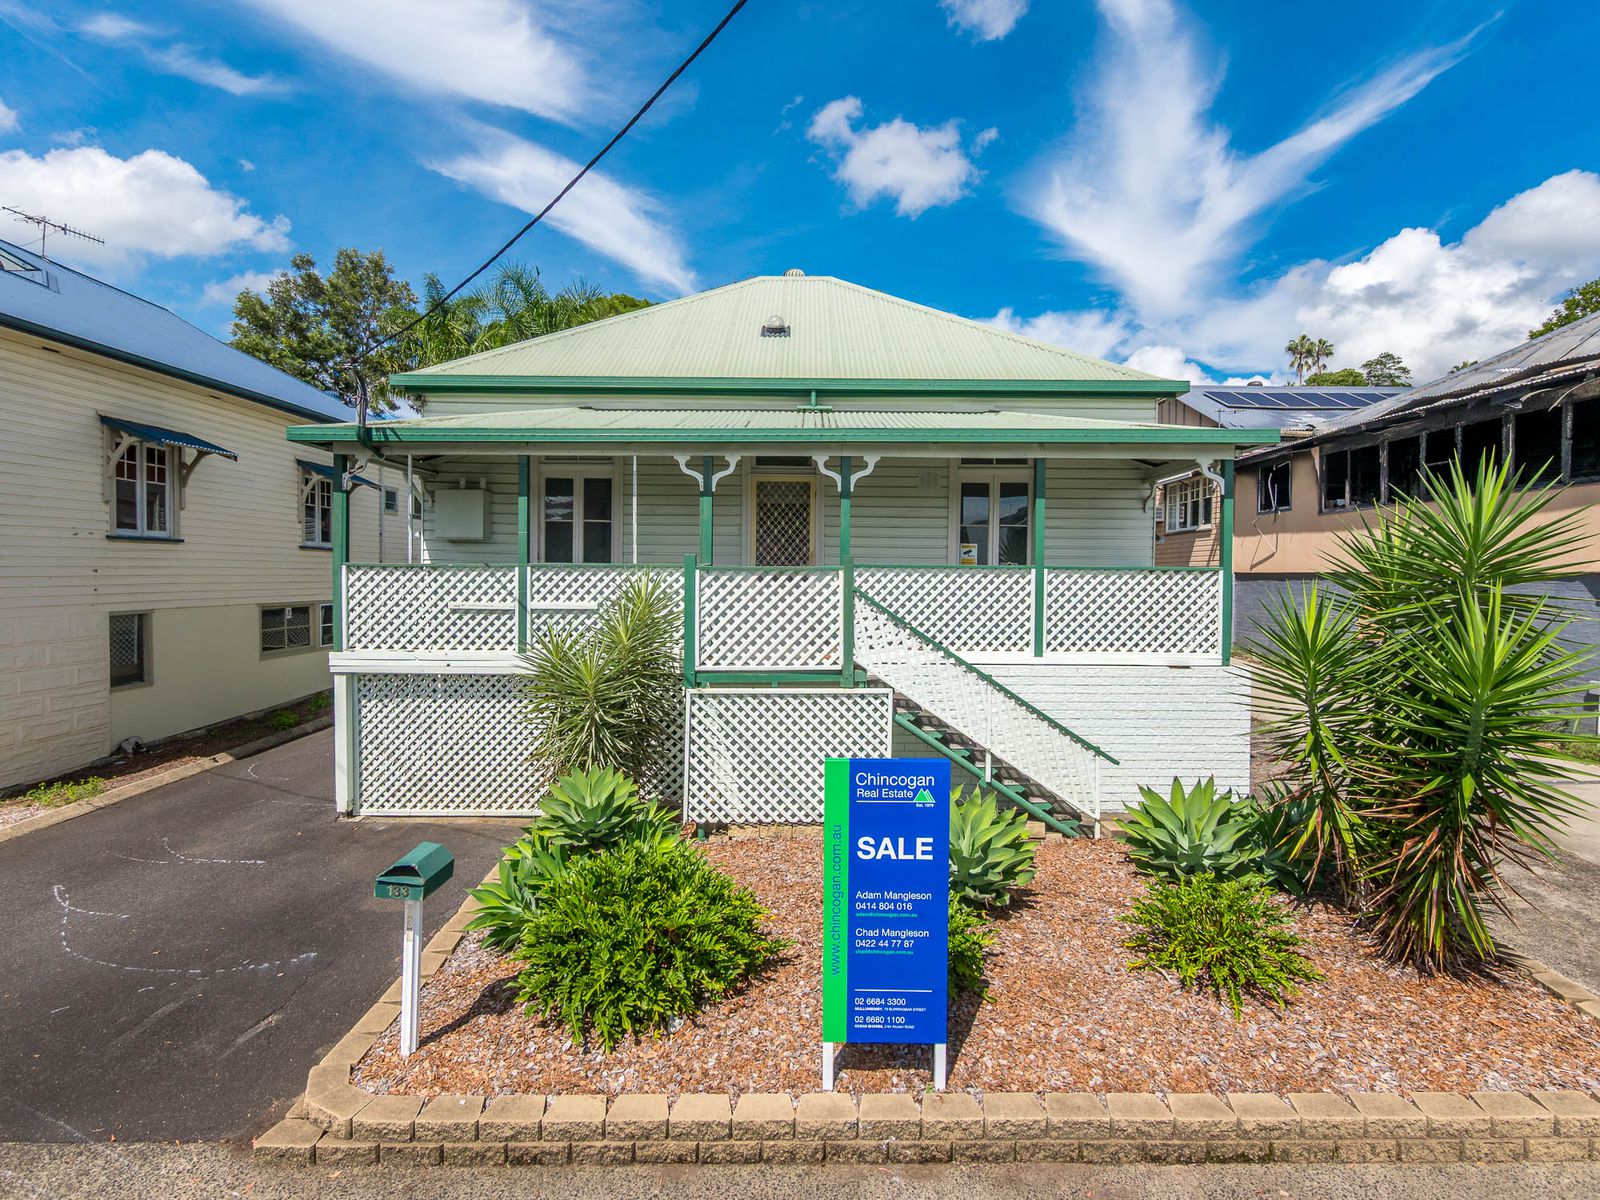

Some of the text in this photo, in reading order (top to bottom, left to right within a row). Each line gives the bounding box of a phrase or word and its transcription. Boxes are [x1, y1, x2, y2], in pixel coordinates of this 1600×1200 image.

[855, 772, 935, 789] Chincogan
[856, 788, 914, 798] Real Estate
[856, 836, 934, 860] SALE
[386, 884, 410, 897] 133
[829, 824, 844, 976] www.chincogan.com.au
[855, 891, 932, 902] Adam Mangleson
[855, 902, 913, 911] 0414 804 016
[855, 928, 930, 939] Chad Mangleson
[855, 939, 914, 948] 0422 44 77 87
[854, 997, 864, 1005] 02
[886, 998, 906, 1006] 3300
[886, 1016, 905, 1024] 1100
